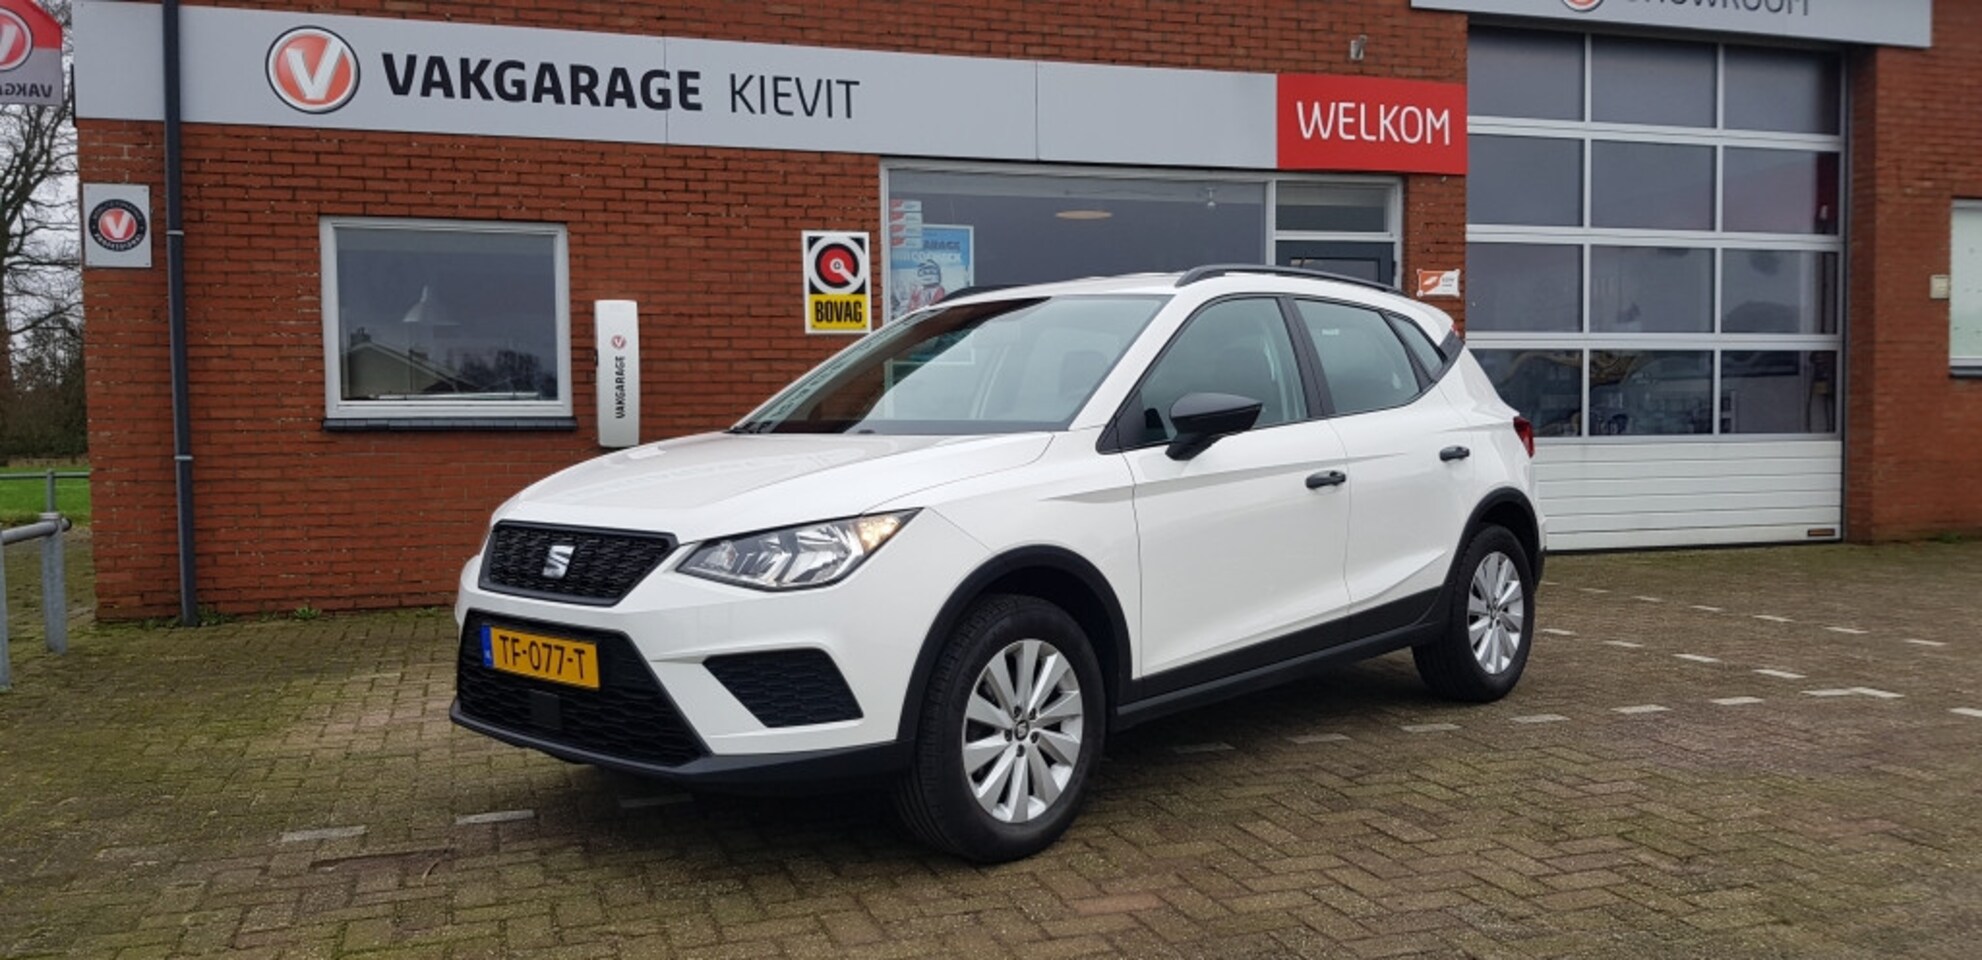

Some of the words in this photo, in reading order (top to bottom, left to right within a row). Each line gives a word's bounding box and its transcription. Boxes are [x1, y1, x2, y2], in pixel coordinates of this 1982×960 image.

[381, 51, 703, 112] VAKGARAGE
[729, 72, 861, 120] KIEVIT
[1296, 101, 1450, 146] WELKOM
[814, 300, 863, 323] BOVAG
[615, 355, 626, 419] VAKGARAGE
[499, 634, 586, 680] TF-077-T
